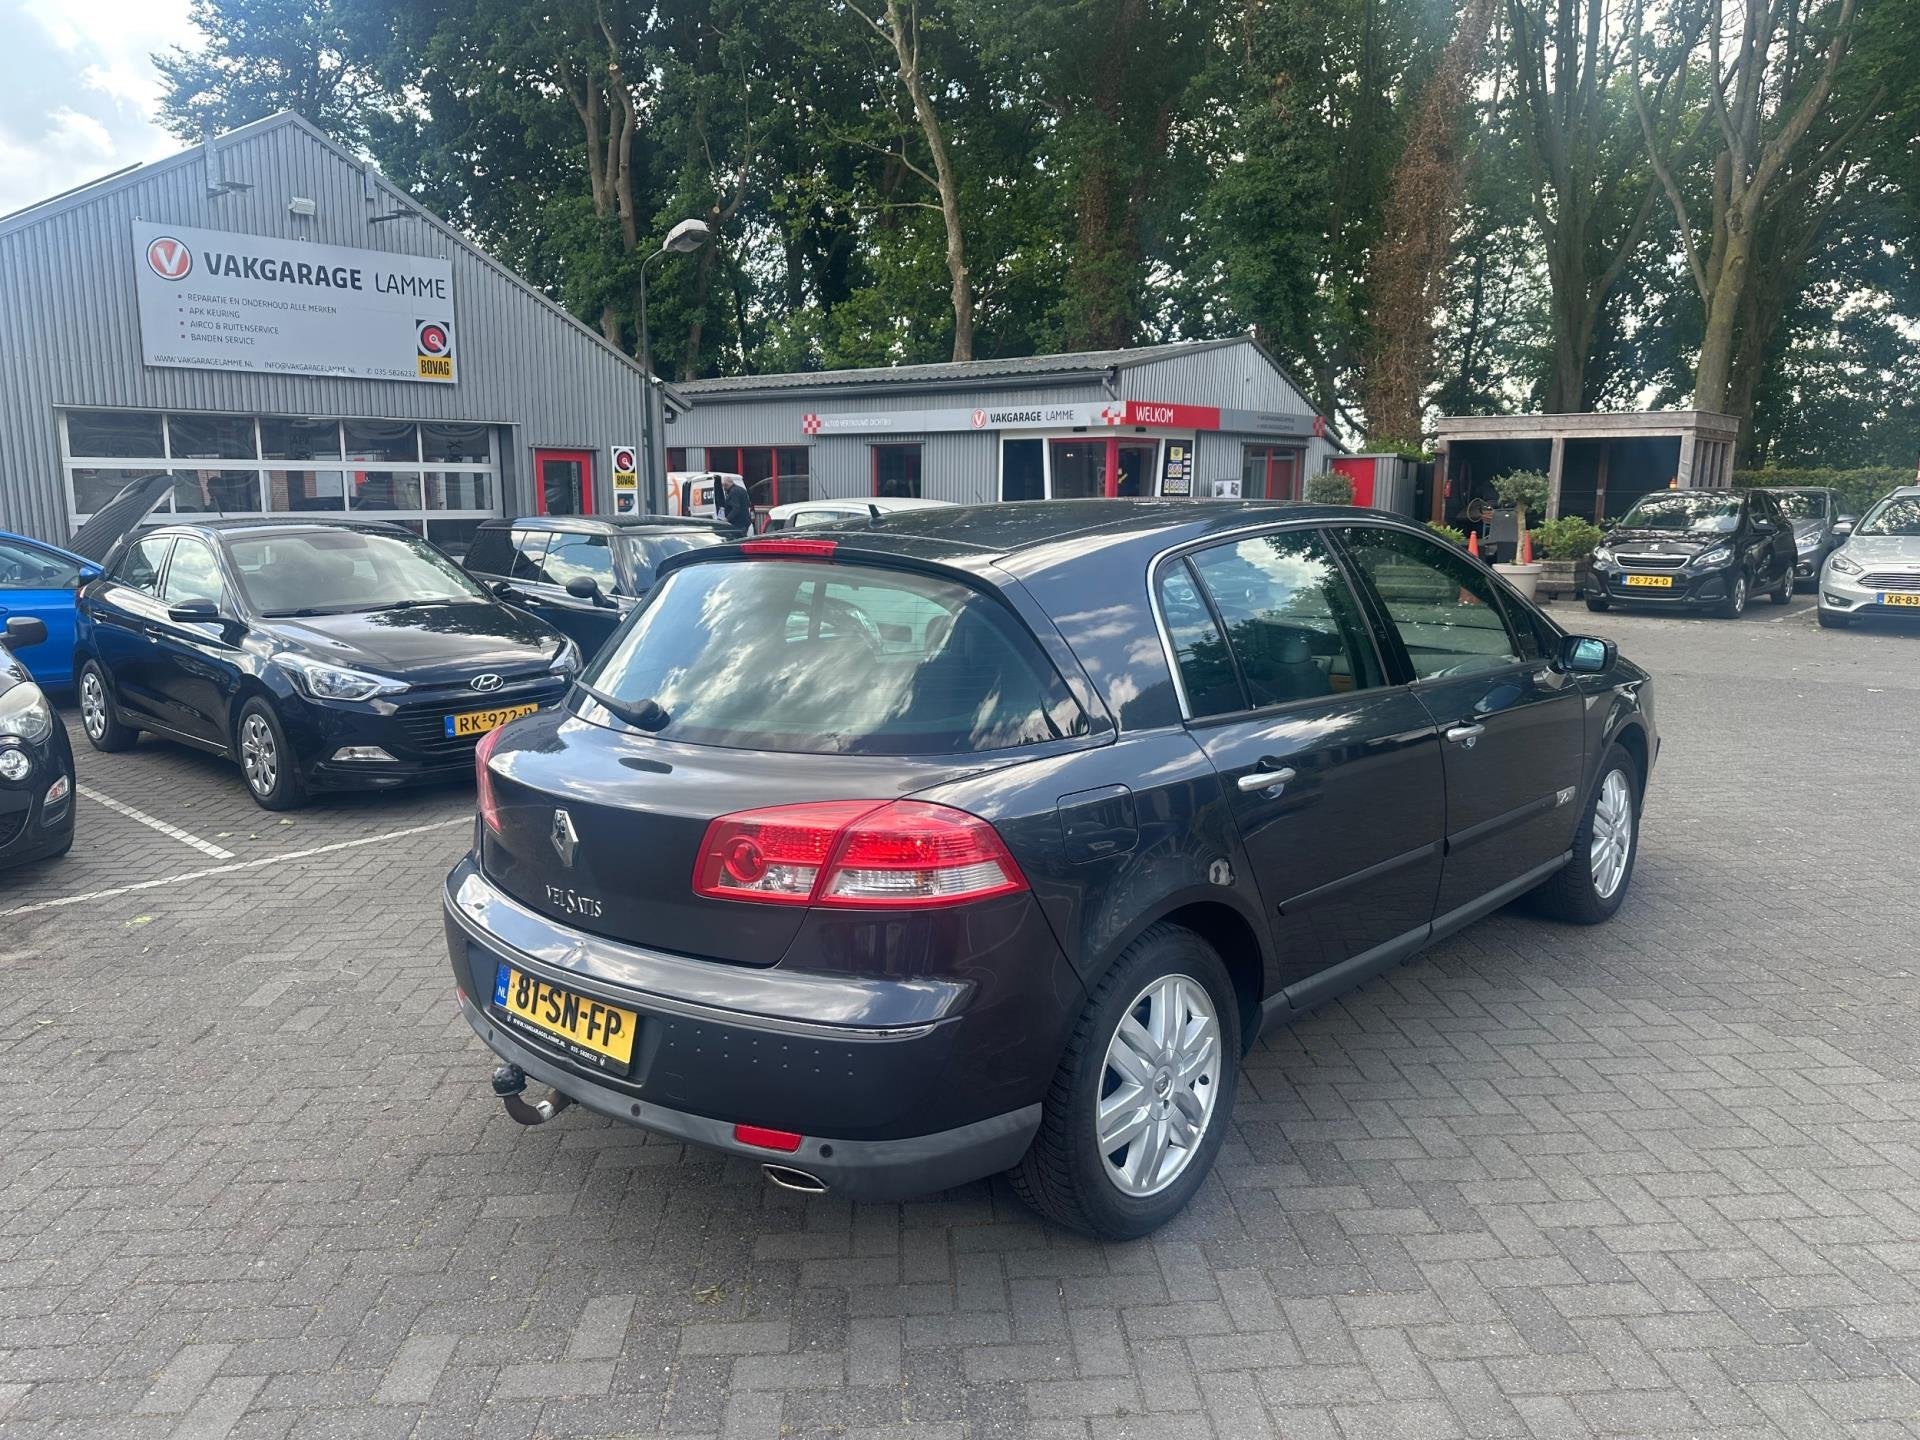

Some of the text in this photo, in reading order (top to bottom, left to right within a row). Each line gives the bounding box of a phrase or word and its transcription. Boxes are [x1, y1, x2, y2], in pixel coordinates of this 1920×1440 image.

[203, 252, 447, 300] VAKGARAGE LAMME
[187, 293, 337, 314] REPARATIE EN ONDERHOUD ALLE MERKEN
[189, 308, 240, 319] APK KEURING
[190, 321, 279, 335] AIRCO & RUITENSERVICE
[191, 333, 255, 345] BANDEN SERVICE
[421, 360, 450, 376] BOVAG
[990, 409, 1074, 423] VAKGARAGE LAMME
[1135, 405, 1174, 424] WELKOM
[616, 474, 635, 486] BOVAG
[1887, 595, 1919, 605] XR-83
[497, 985, 507, 999] NL
[515, 973, 623, 1047] 81-SN-FP
